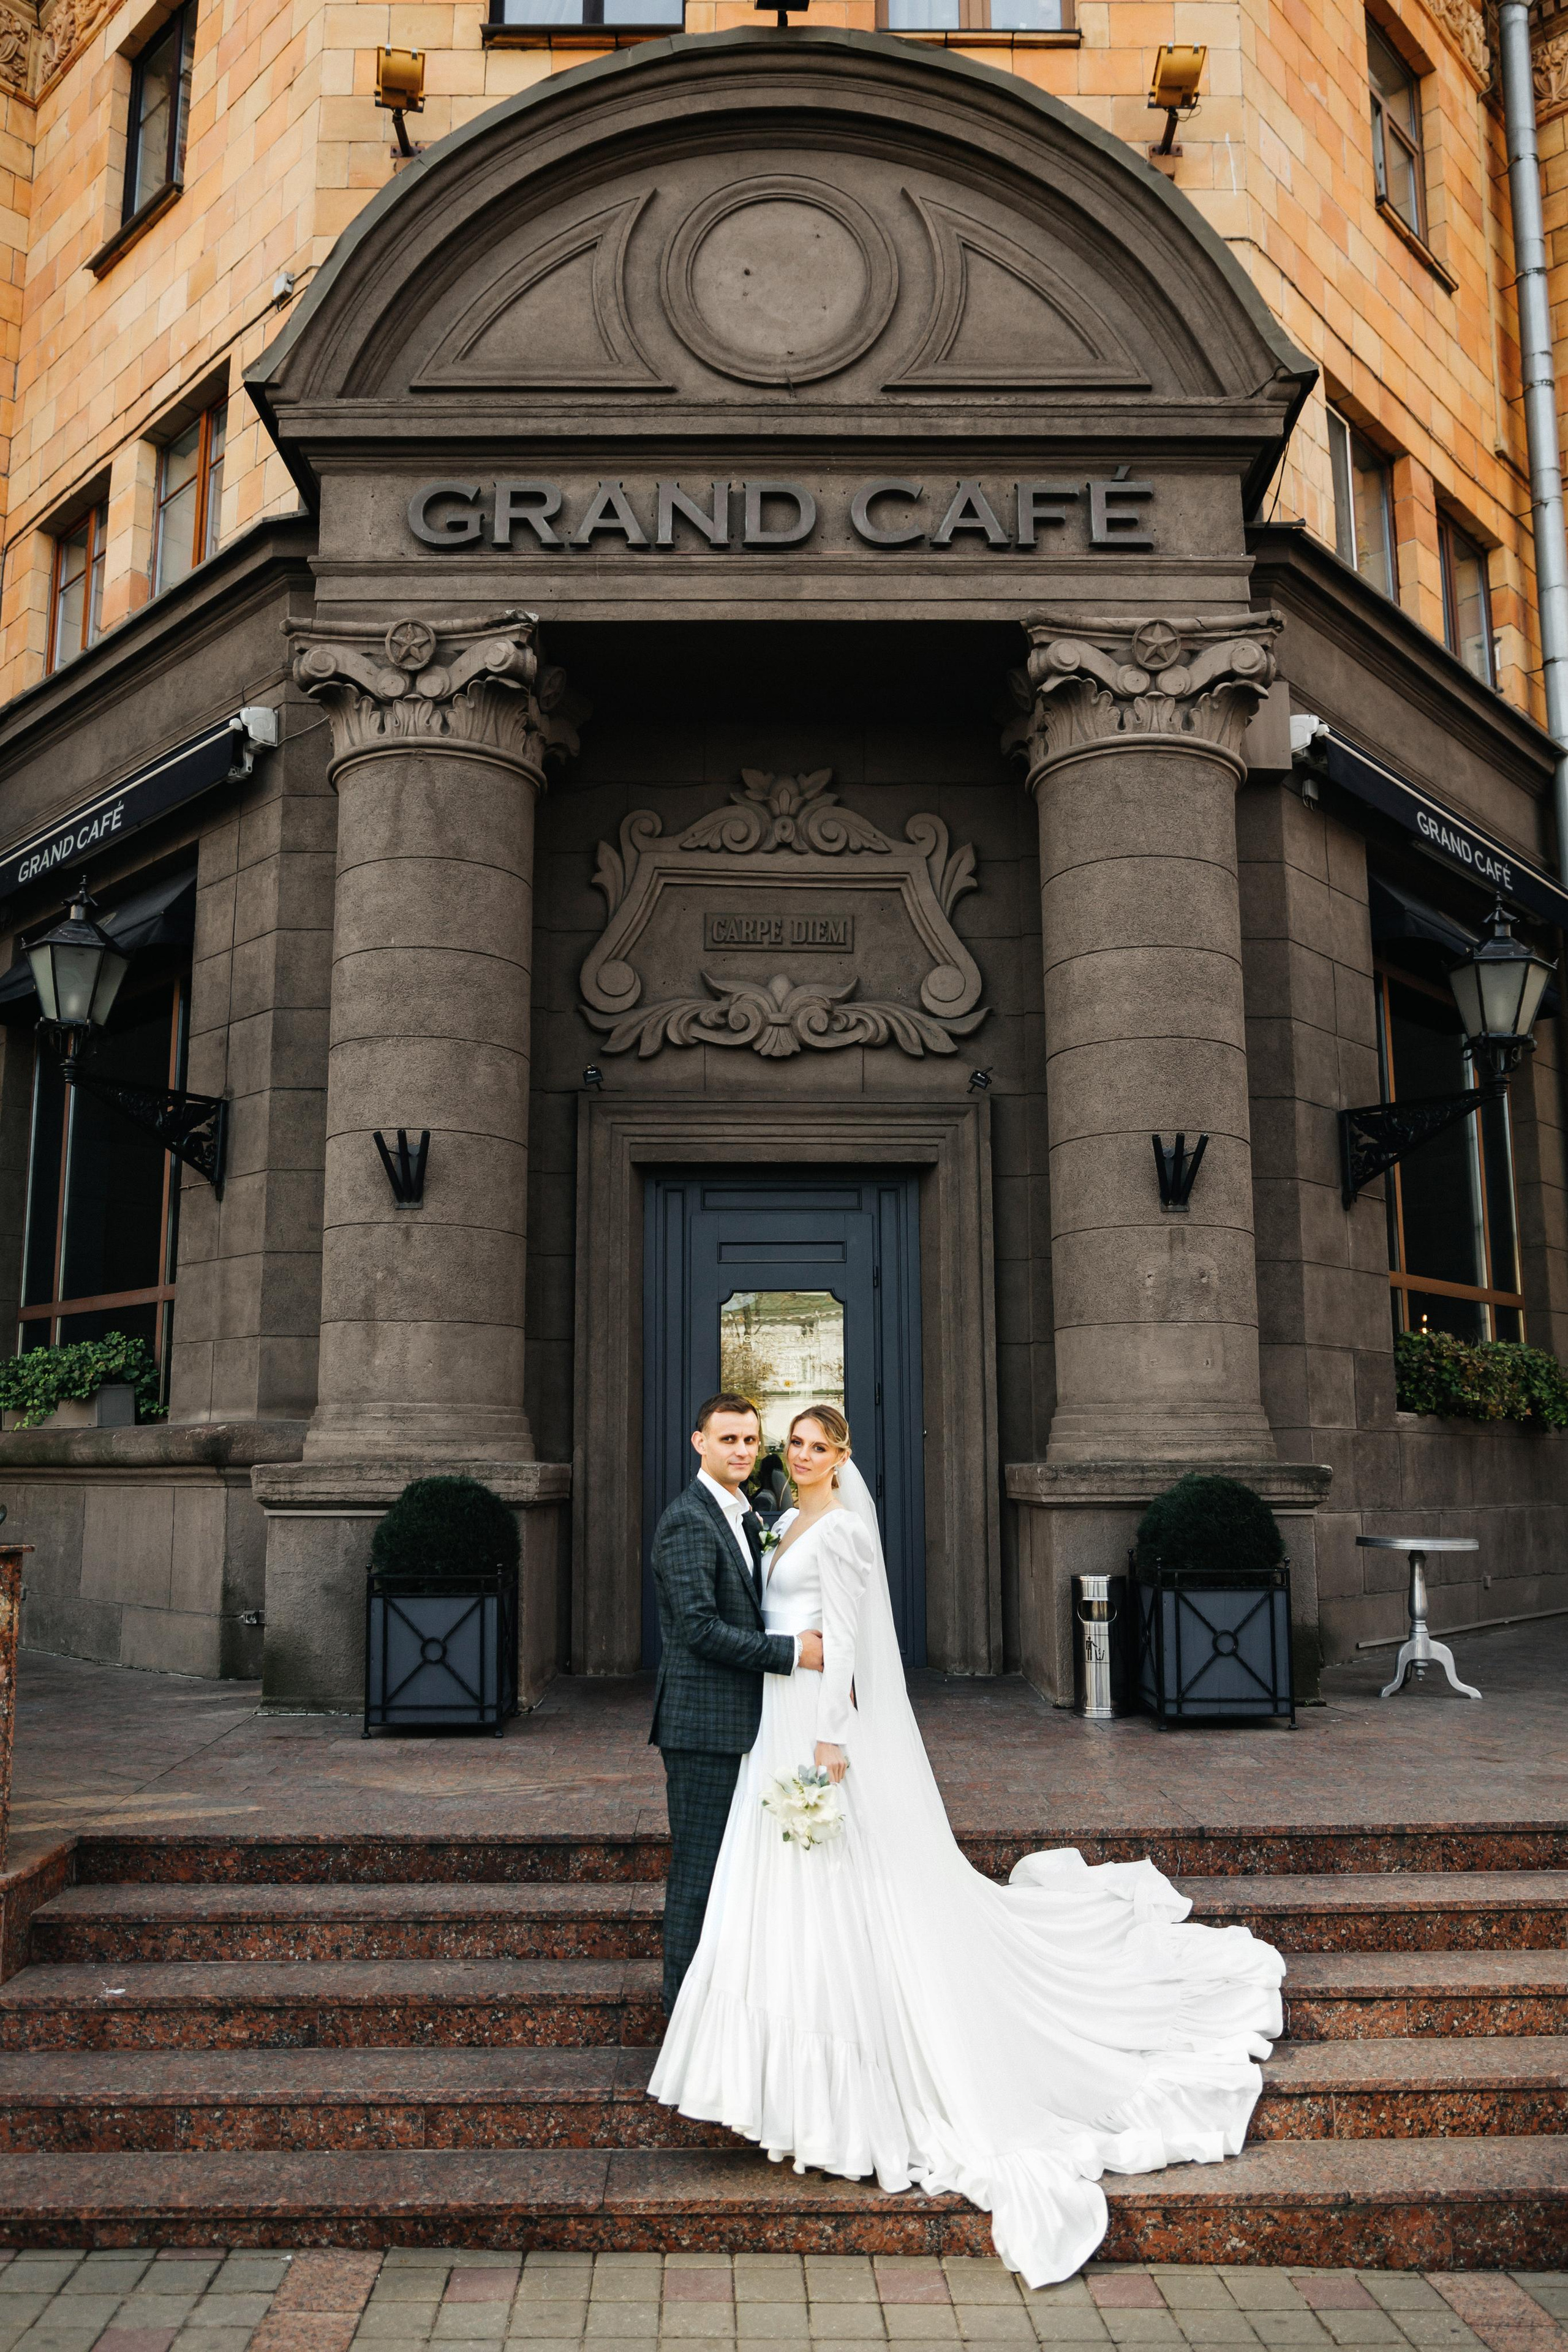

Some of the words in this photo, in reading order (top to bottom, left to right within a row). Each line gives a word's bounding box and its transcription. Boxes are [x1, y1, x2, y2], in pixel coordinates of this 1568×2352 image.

[408, 481, 816, 548] GRAND
[851, 466, 1155, 549] CAFÉ
[18, 835, 74, 882] GRAND
[77, 801, 124, 849] CAFÉ
[1417, 812, 1472, 864] GRAND
[1474, 851, 1513, 891] CAFÉ
[712, 919, 783, 944] CARPE
[791, 920, 847, 945] DIEM
